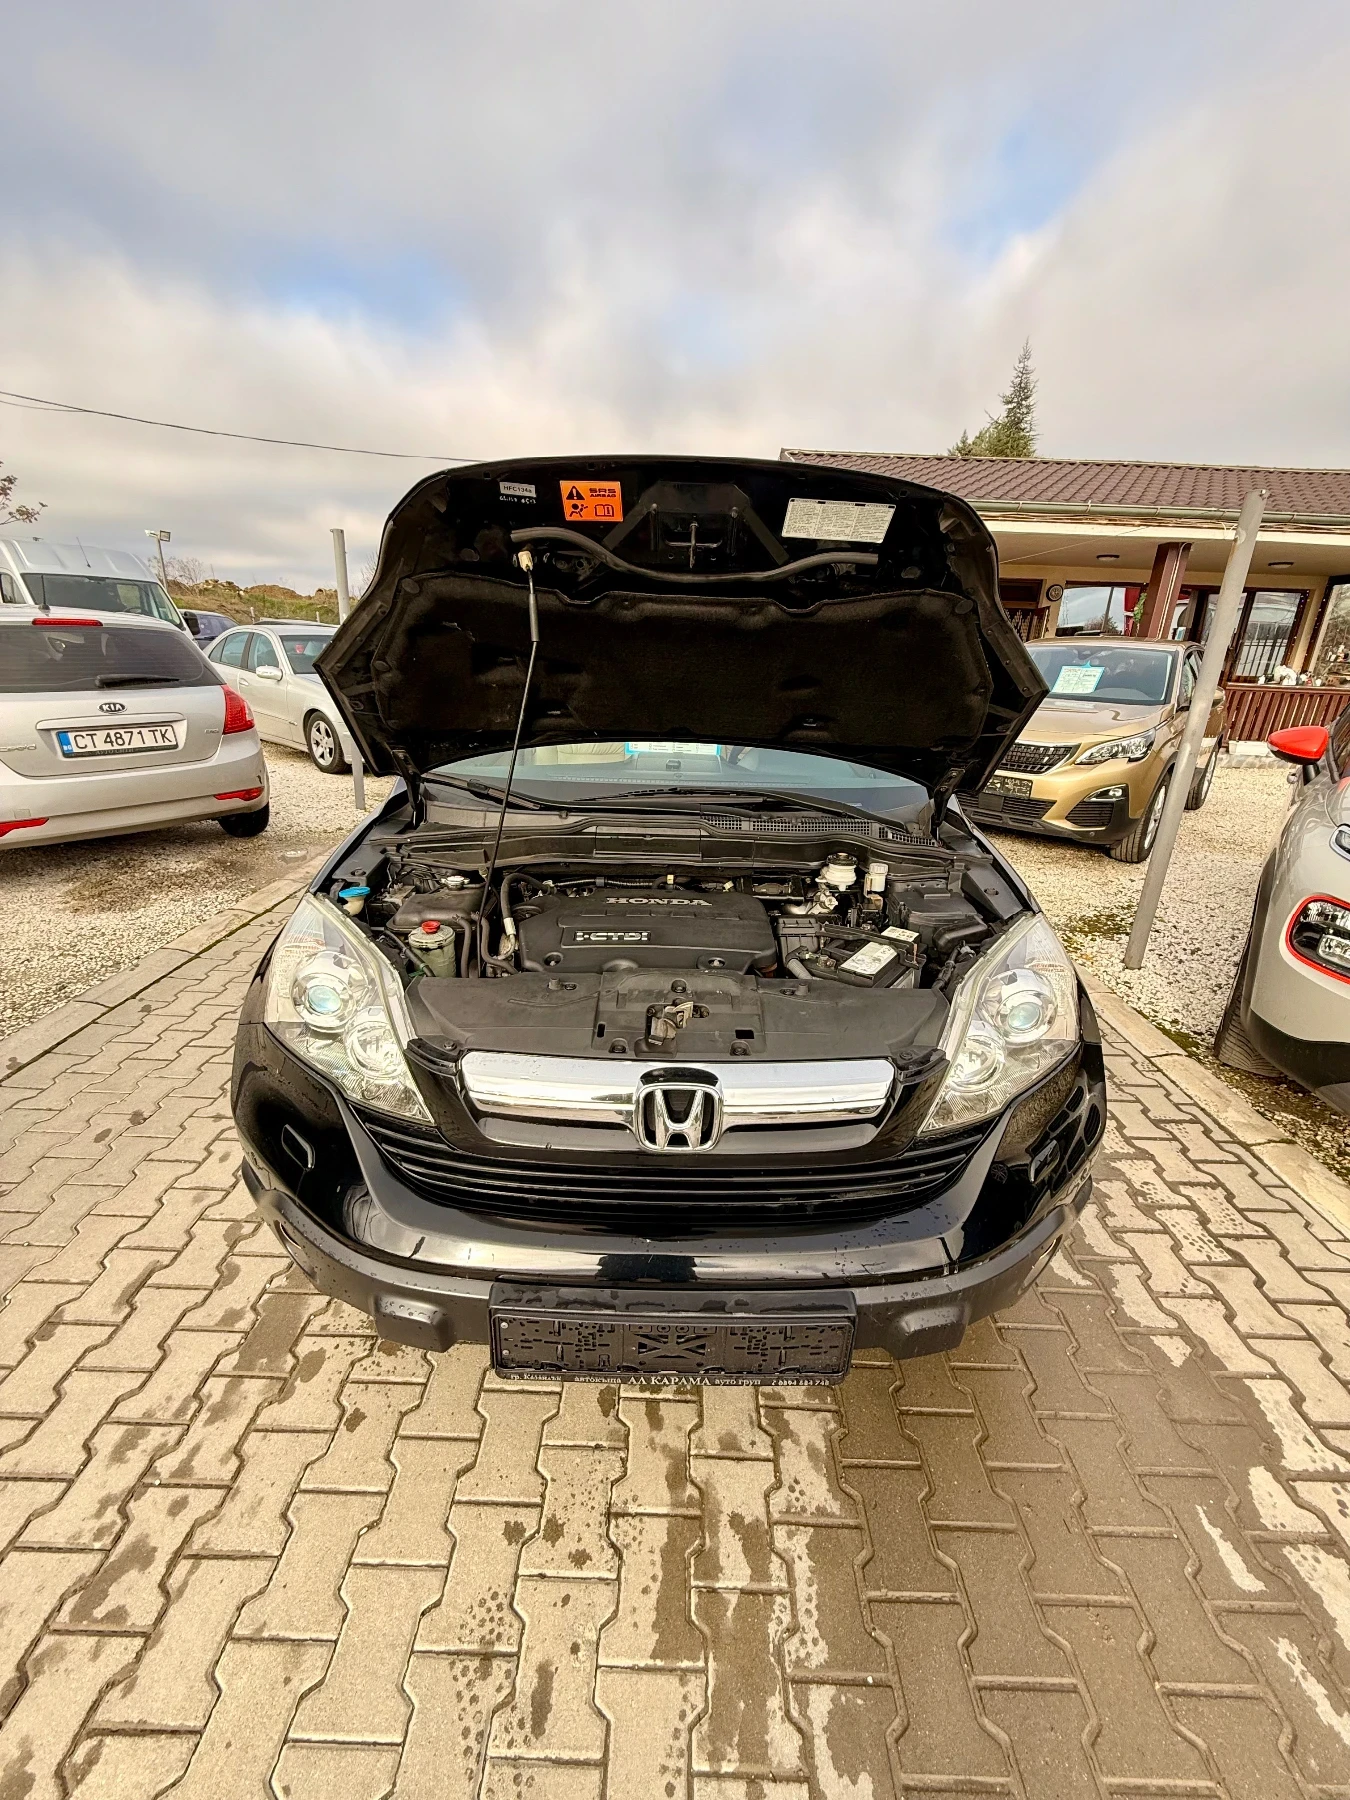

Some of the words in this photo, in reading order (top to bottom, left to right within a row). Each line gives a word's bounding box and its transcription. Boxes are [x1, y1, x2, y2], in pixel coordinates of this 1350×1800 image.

[73, 733, 97, 750] CT
[104, 730, 146, 748] 4871
[148, 728, 172, 744] TK
[606, 898, 713, 906] HONDA
[650, 1376, 711, 1386] КАРАМА
